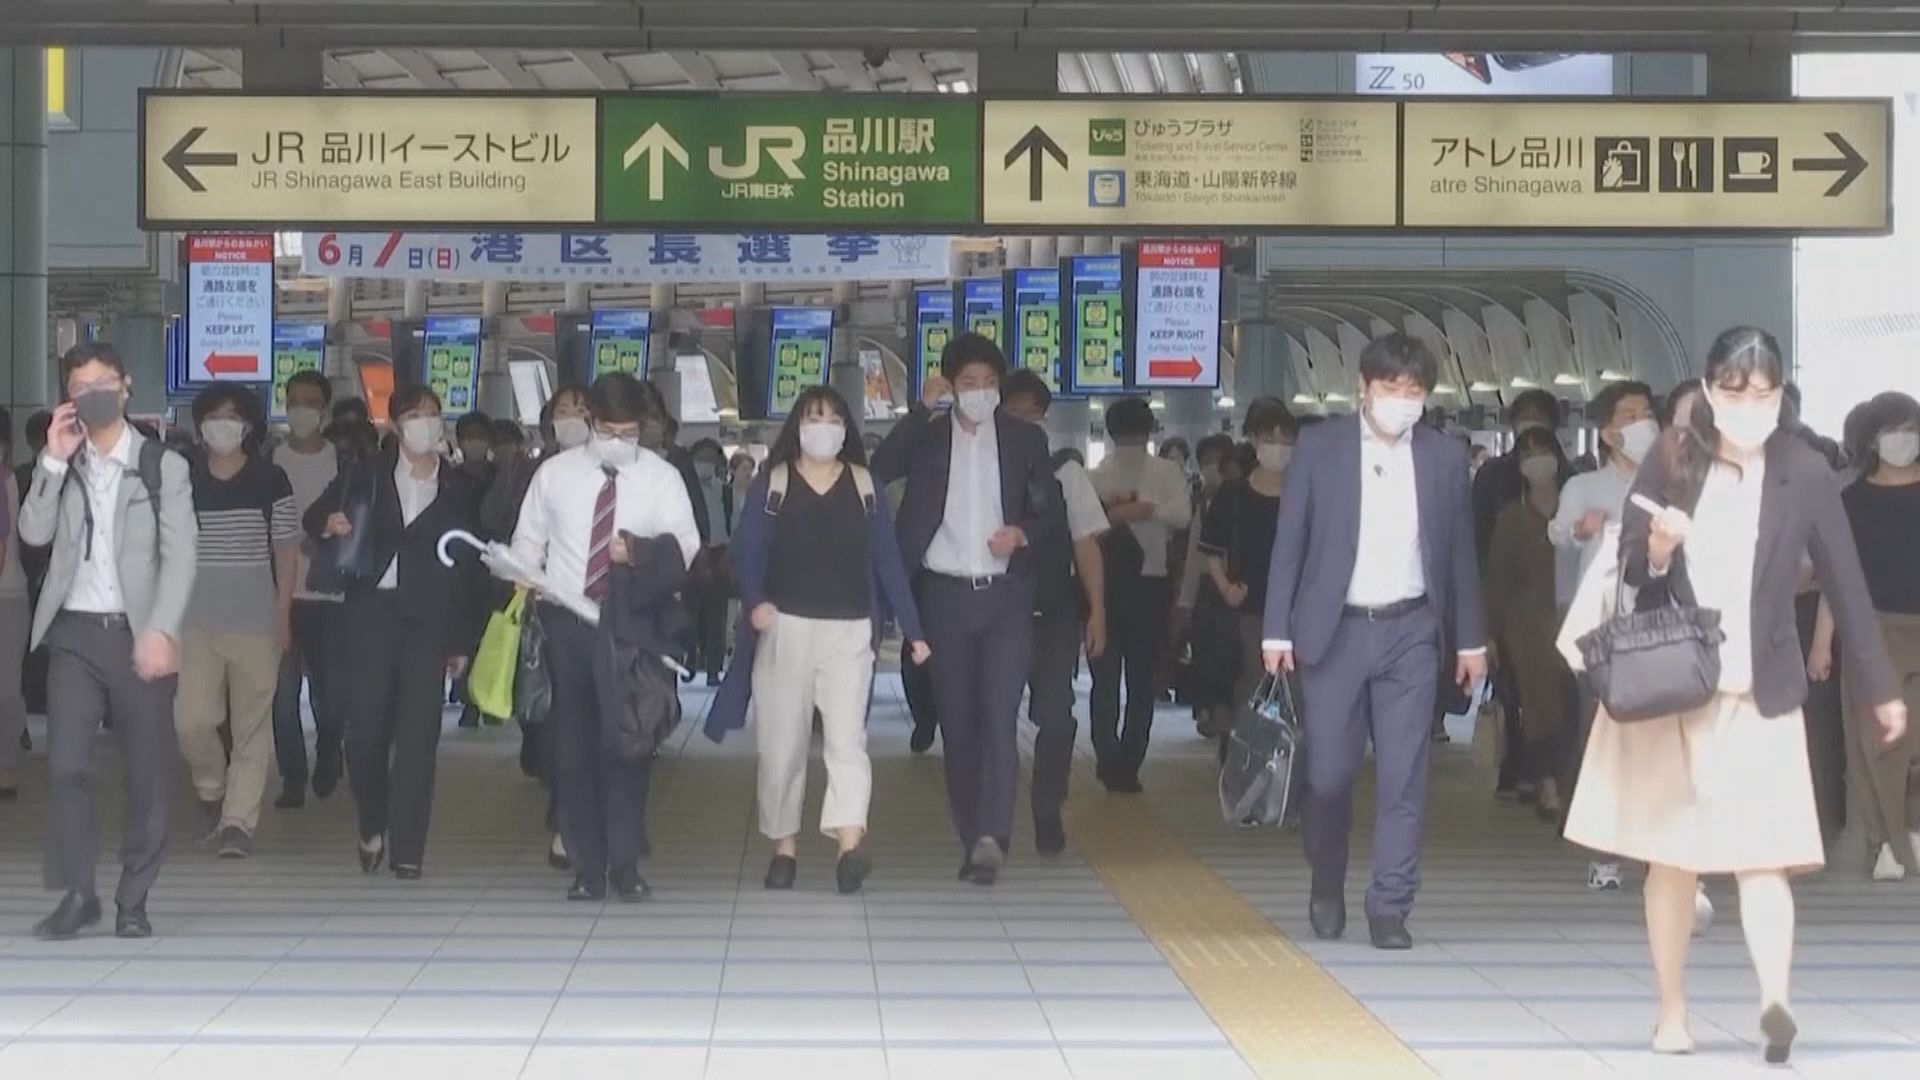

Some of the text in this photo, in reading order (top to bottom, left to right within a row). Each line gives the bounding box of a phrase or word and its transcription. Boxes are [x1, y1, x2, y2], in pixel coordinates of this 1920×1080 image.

[1403, 73, 1425, 90] 50
[822, 118, 935, 155] 品川駅
[1135, 119, 1234, 138] びゅうプラザ
[252, 131, 570, 165] JR 品川イーストビル
[708, 125, 806, 179] JR
[1431, 137, 1583, 169] アトレ品川
[252, 171, 526, 193] JR Shinagawa East Building
[823, 161, 949, 186] Shinagawa
[721, 183, 795, 199] JR東日本
[1430, 176, 1583, 197] atre Shinagawa
[823, 188, 904, 209] Station
[214, 251, 247, 260] NOTICE
[1163, 257, 1195, 266] NOTICE
[205, 325, 256, 335] KEEP LEFT
[1150, 329, 1205, 339] KEEP RIGHT
